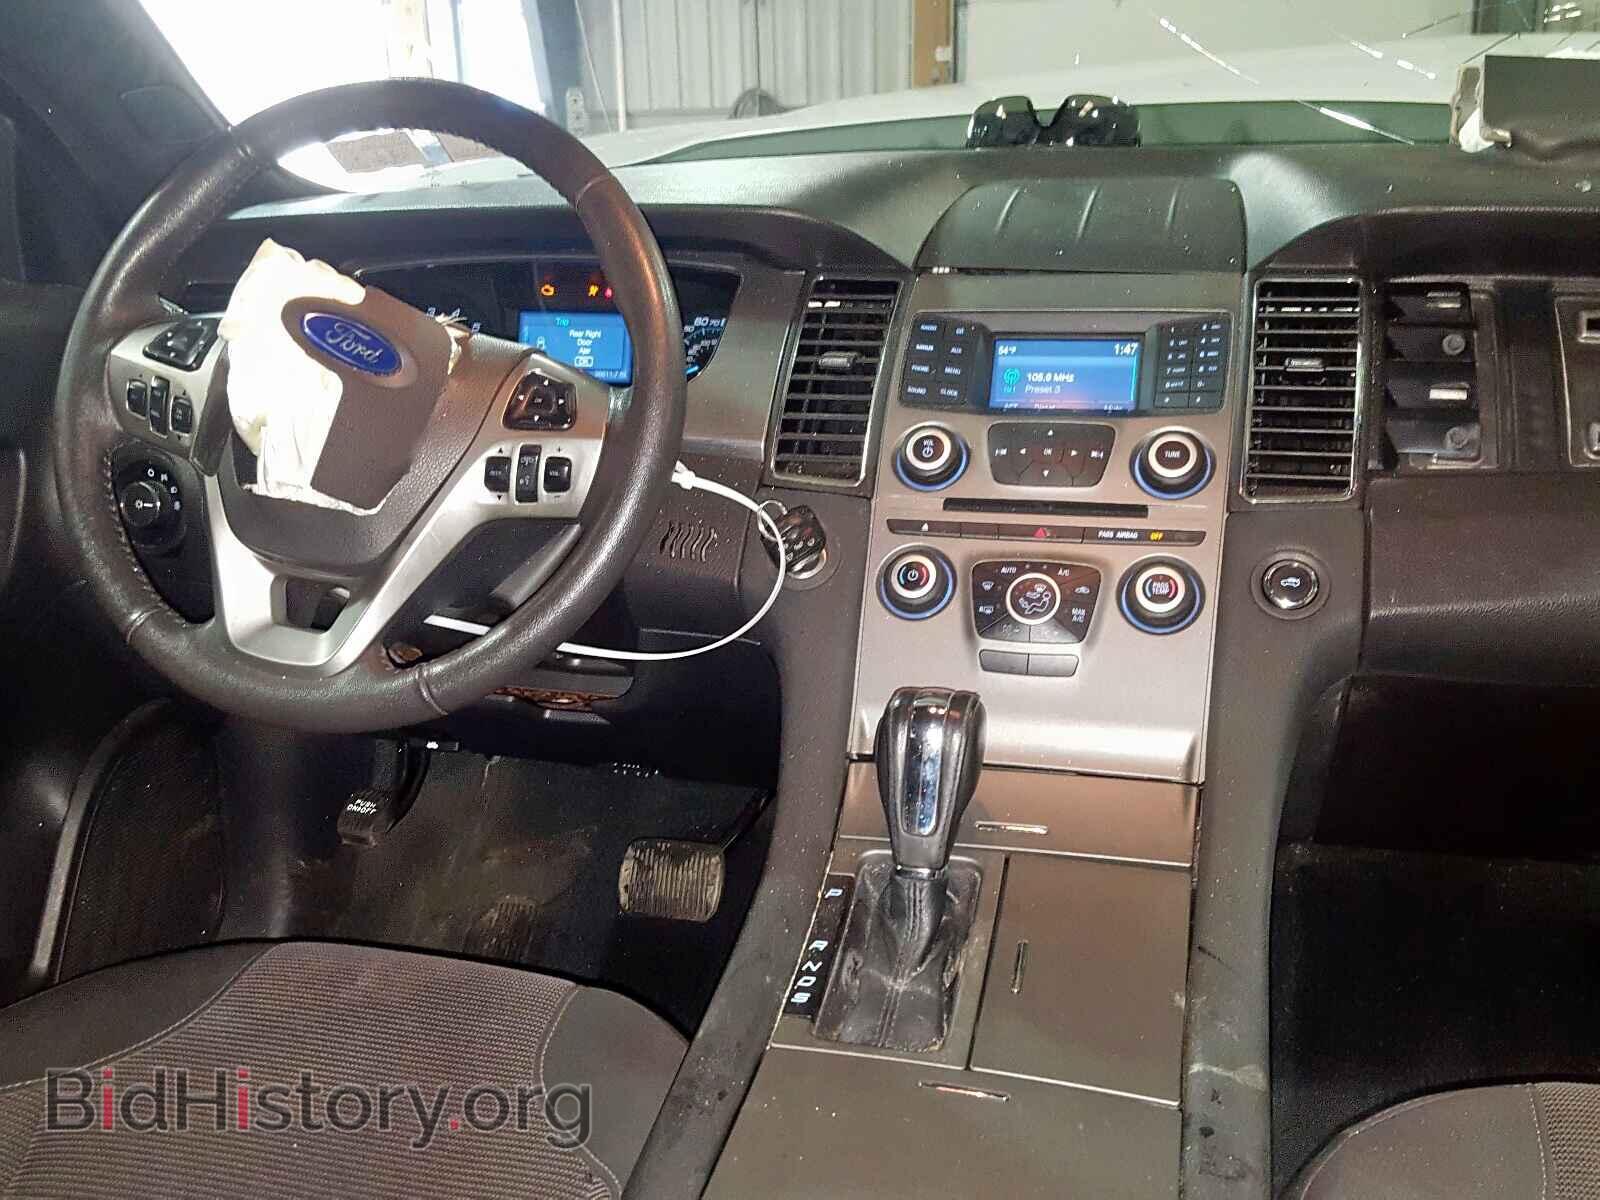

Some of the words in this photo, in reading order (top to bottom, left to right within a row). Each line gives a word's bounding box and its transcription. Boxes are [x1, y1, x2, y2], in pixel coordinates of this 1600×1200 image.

[325, 321, 384, 364] Ford
[1114, 342, 1138, 356] 1:47
[1025, 384, 1053, 394] Preset
[1164, 449, 1182, 459] TUNE
[1150, 532, 1164, 541] OFF
[1000, 566, 1017, 575] AUTO
[354, 799, 377, 808] PUSH
[824, 888, 843, 899] P
